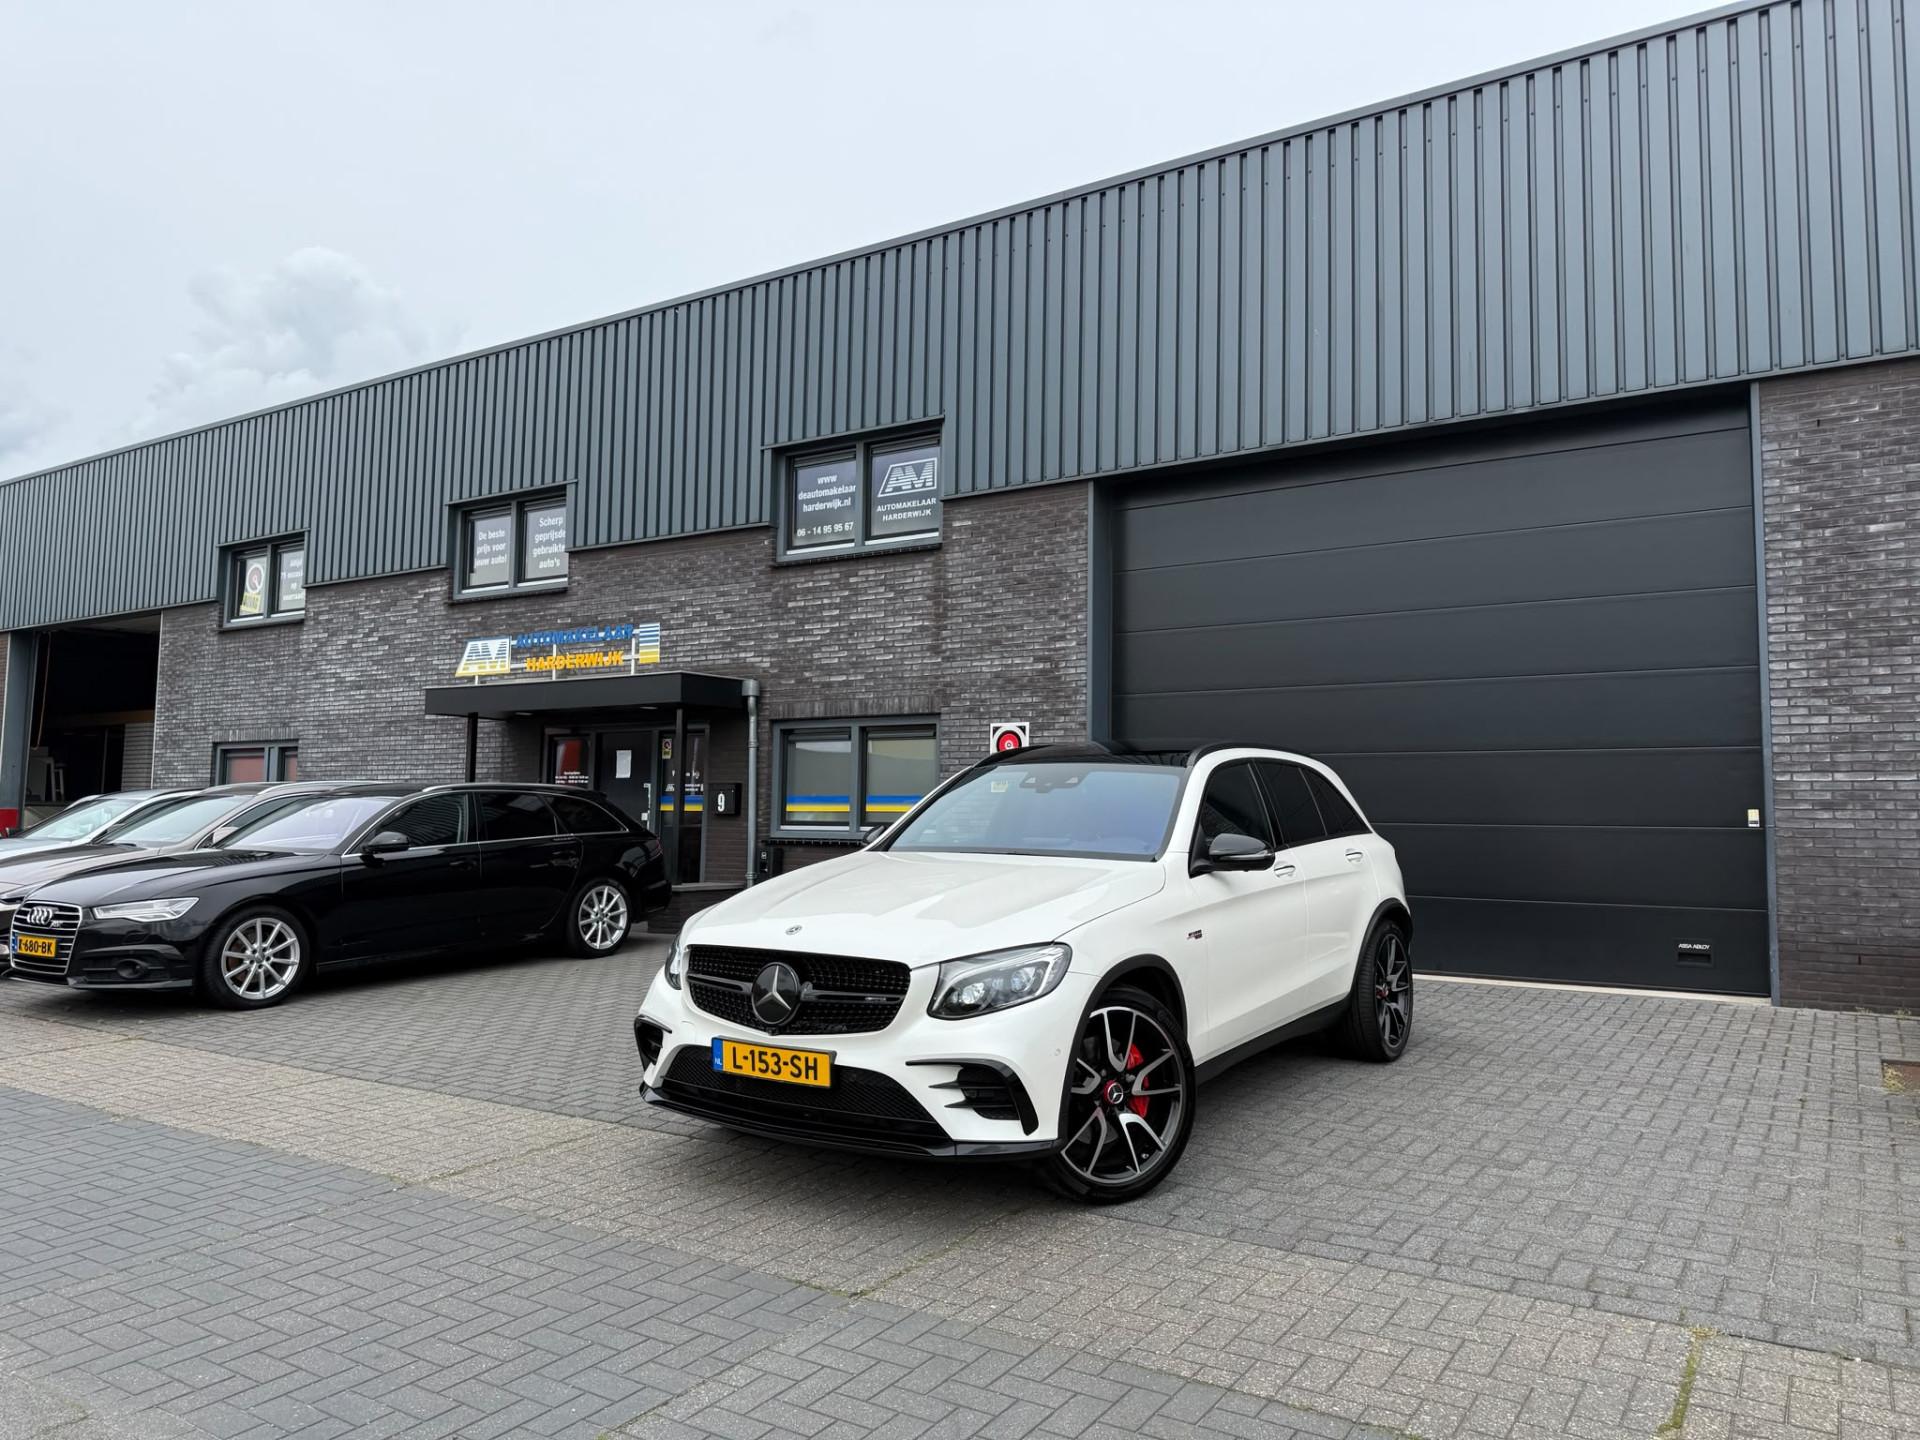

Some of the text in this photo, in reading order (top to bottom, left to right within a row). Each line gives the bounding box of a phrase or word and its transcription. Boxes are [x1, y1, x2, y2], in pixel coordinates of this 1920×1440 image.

[817, 474, 838, 484] www
[798, 484, 856, 500] deautomakelaar
[802, 497, 852, 513] harderwijk.nl
[876, 498, 937, 512] AUTOMAKELAAR
[538, 517, 563, 527] Scherp
[882, 509, 932, 522] HARDERWIJK
[478, 529, 505, 540] De beste
[797, 528, 806, 537] 06
[813, 526, 822, 535] 14
[823, 524, 833, 534] 95
[833, 523, 843, 533] 95
[844, 522, 854, 531] 67
[492, 543, 506, 551] voor
[516, 624, 634, 648] AUTOMAKELAAR
[526, 651, 624, 672] HARDERWIJK
[717, 793, 725, 812] 9
[732, 1046, 818, 1081] L-153-SH
